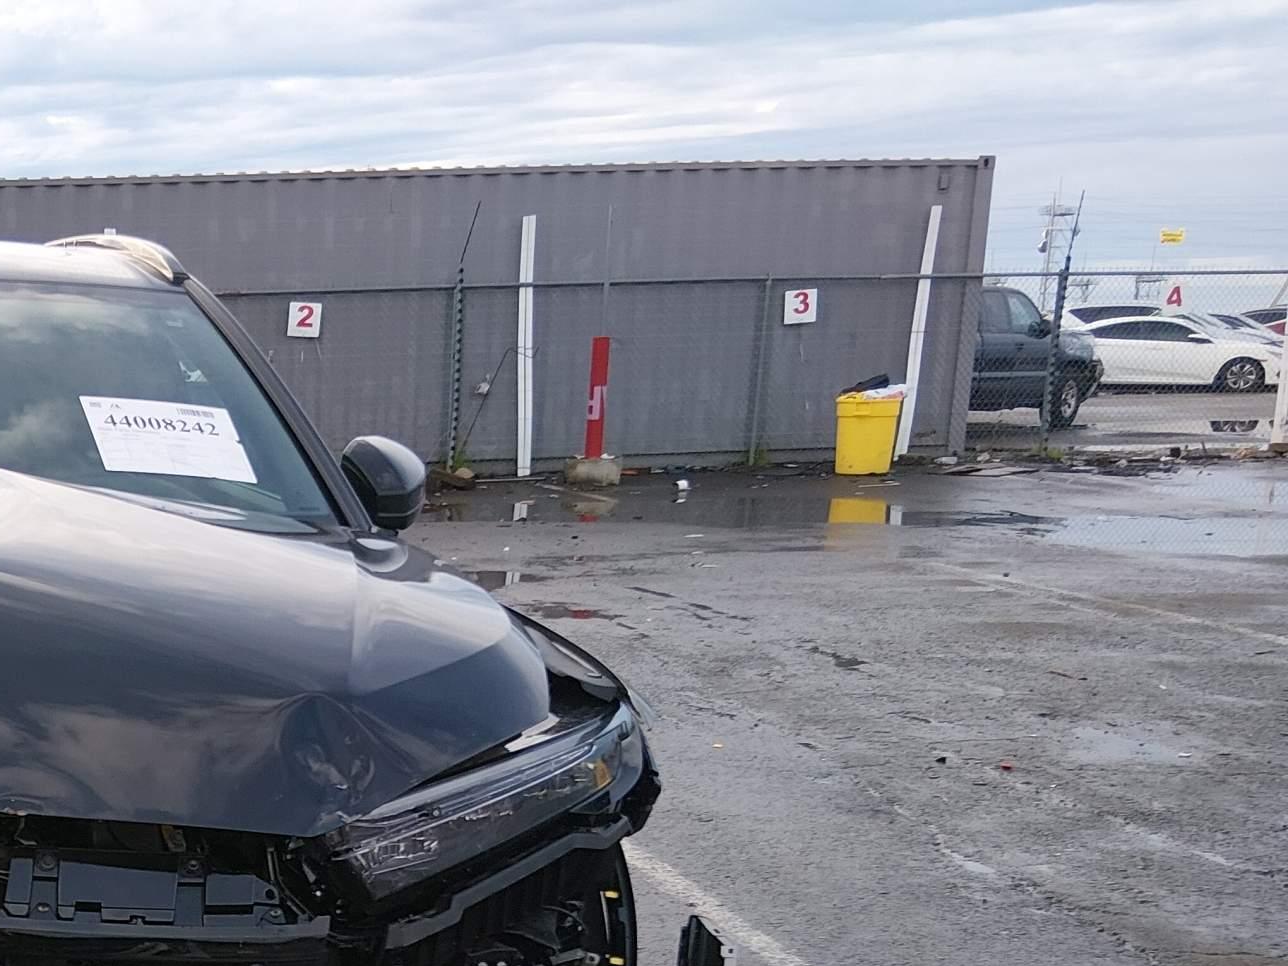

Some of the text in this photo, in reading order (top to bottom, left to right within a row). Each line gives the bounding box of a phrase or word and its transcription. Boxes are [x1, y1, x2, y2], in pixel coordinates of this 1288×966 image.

[793, 291, 810, 315] 3
[1166, 286, 1182, 307] 4
[296, 305, 314, 328] 2
[104, 413, 220, 437] 44008242
